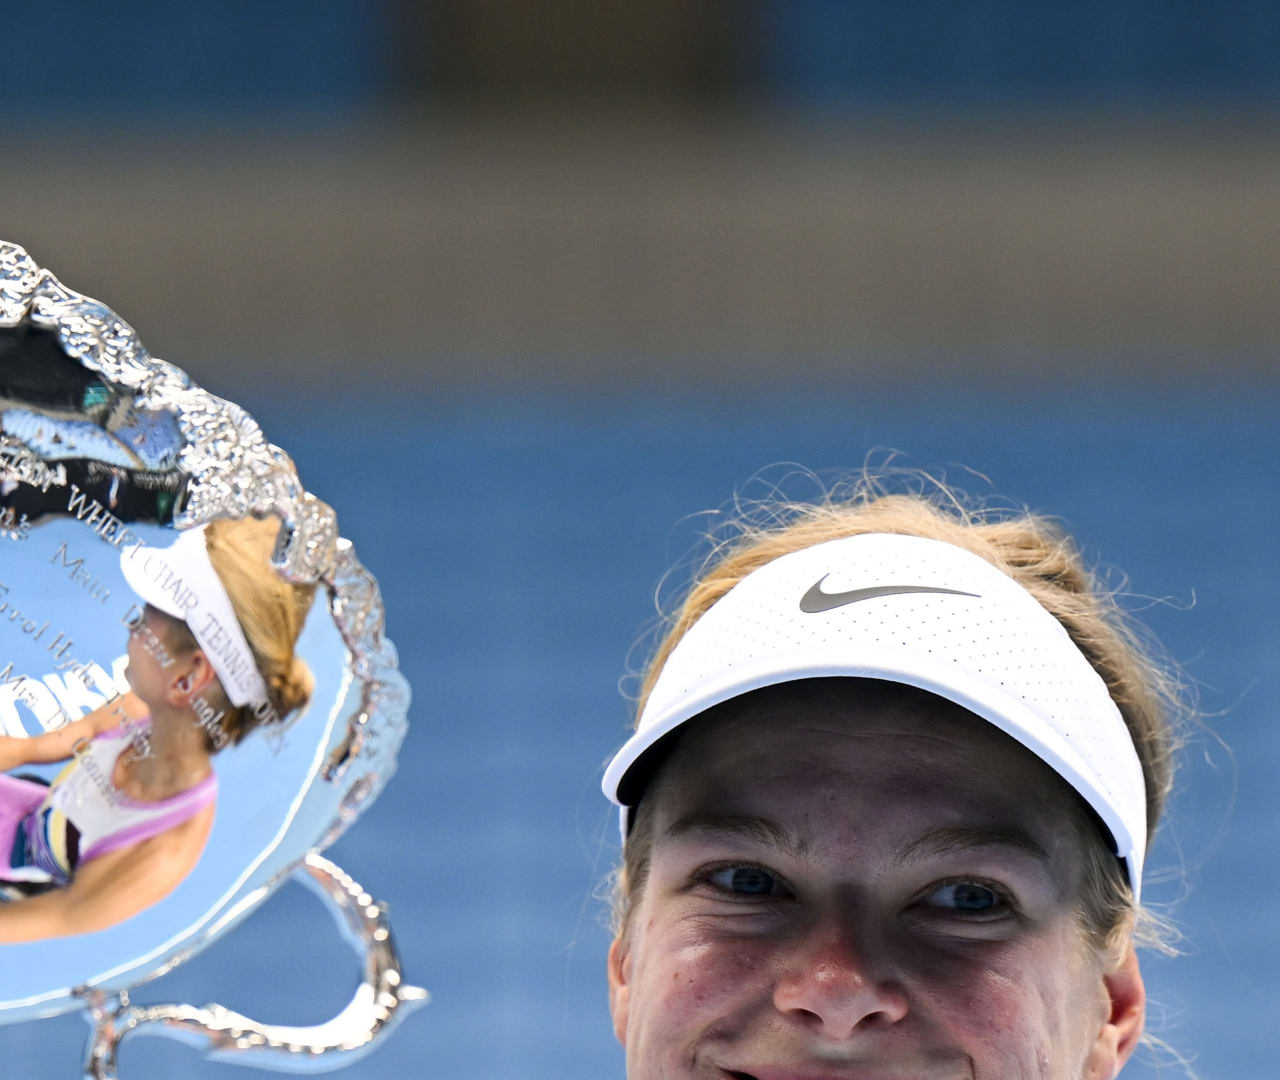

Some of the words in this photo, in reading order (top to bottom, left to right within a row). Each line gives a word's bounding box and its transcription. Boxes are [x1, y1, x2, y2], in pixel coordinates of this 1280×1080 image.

[49, 542, 112, 604] Main
[120, 603, 176, 669] Draw
[68, 484, 200, 615] WHEELCHAIR
[198, 612, 259, 695] TENNIS
